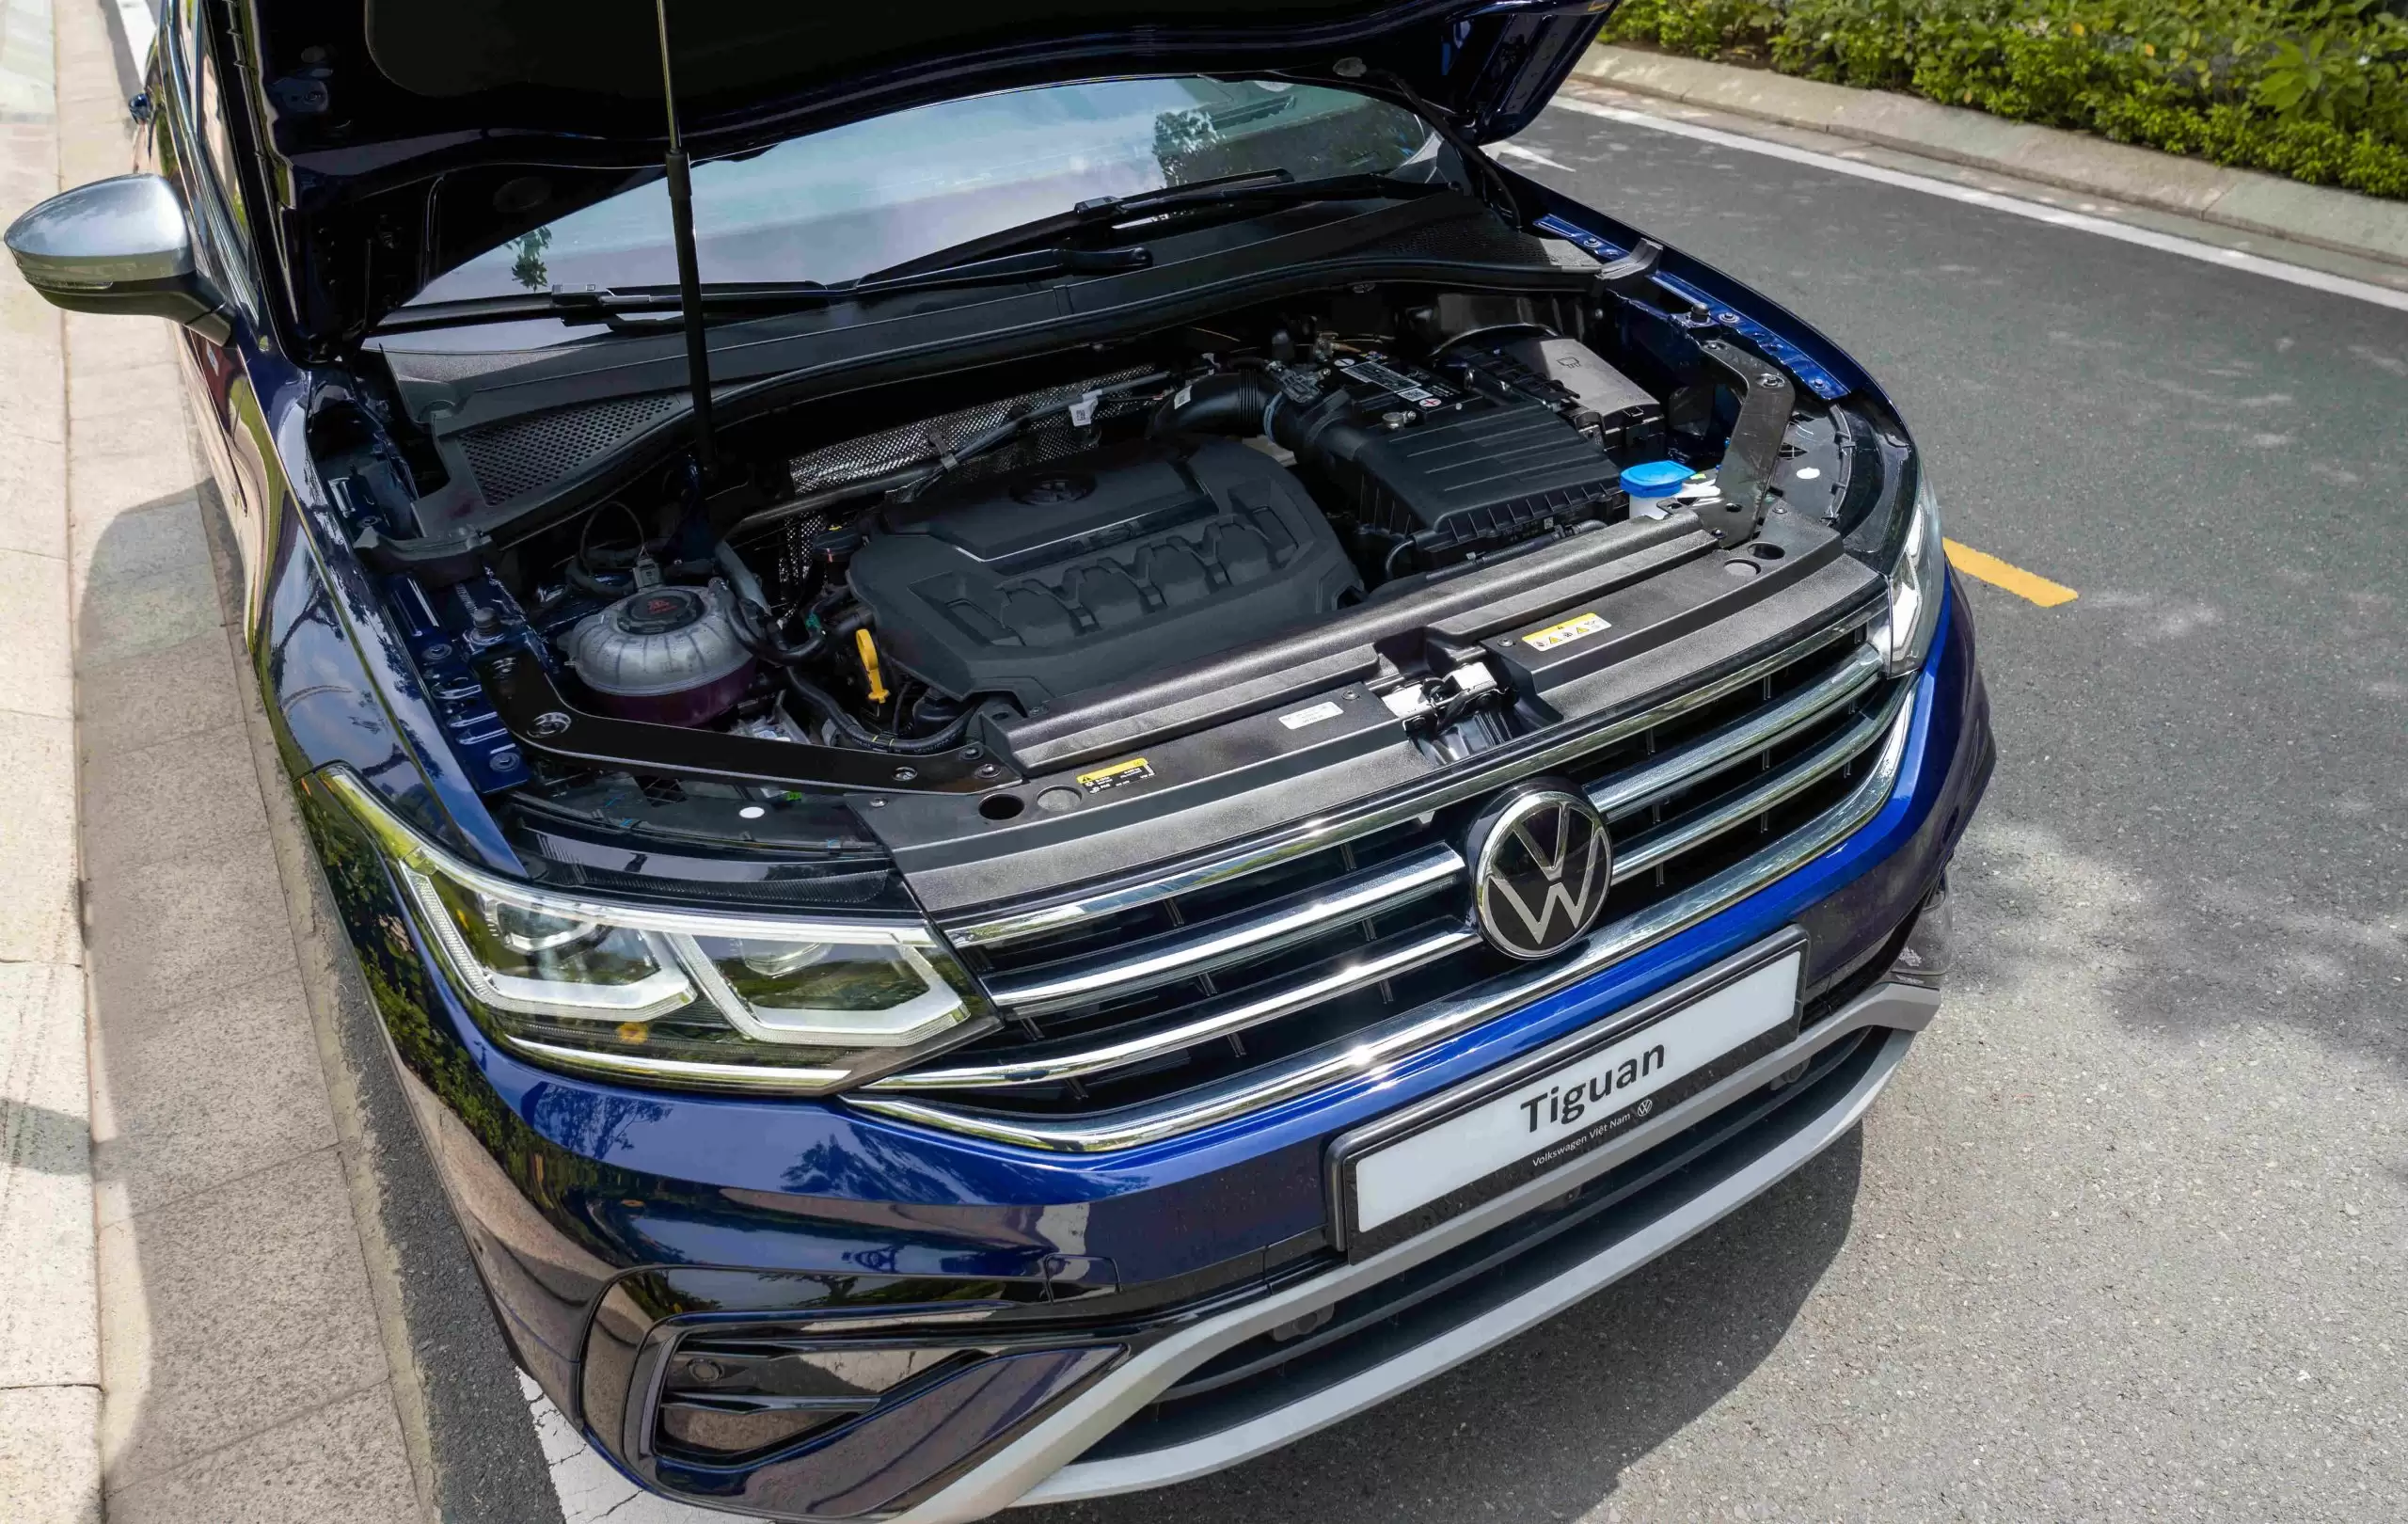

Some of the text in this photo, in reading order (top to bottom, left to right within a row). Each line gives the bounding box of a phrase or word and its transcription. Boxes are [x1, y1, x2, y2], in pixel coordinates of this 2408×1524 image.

[1521, 1043, 1665, 1133] Tiguan
[1532, 1136, 1587, 1167] Volkswagen
[1590, 1123, 1608, 1138] Việt
[1609, 1113, 1631, 1129] Nam
